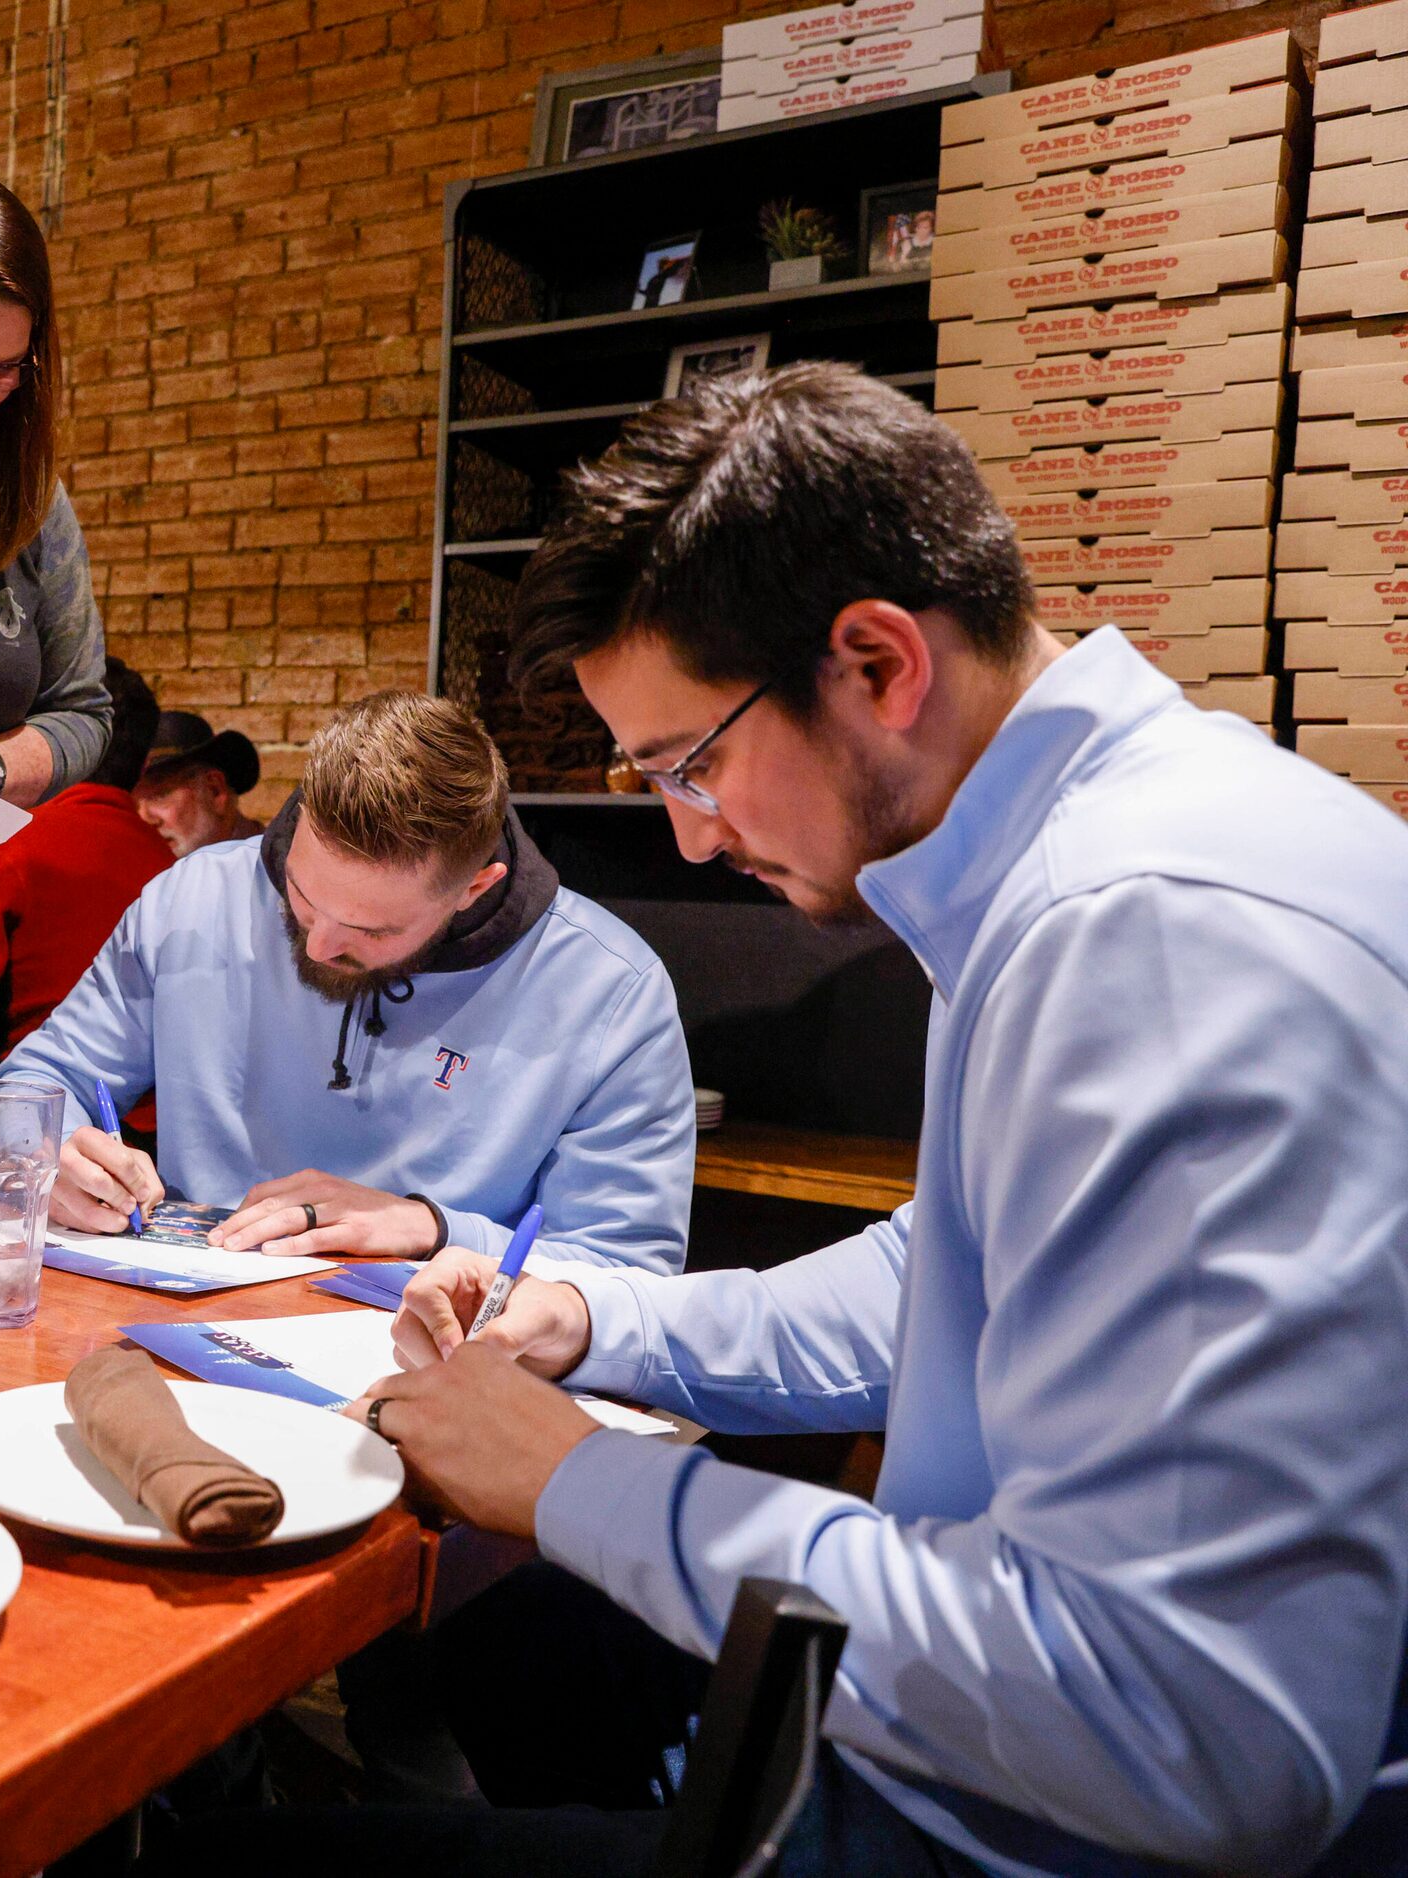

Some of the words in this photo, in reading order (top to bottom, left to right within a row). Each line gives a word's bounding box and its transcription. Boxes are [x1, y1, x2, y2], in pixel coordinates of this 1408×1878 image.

[785, 16, 835, 33] CANE
[857, 1, 914, 19] ROSSO
[784, 54, 833, 70] CANE
[856, 40, 912, 58] ROSSO
[780, 92, 829, 107] CANE
[851, 78, 907, 95] ROSSO
[1021, 87, 1086, 109] CANE
[1115, 64, 1191, 89] ROSSO
[1020, 134, 1086, 155] CANE
[1114, 114, 1191, 137] ROSSO
[1015, 182, 1080, 201] CANE
[1109, 164, 1185, 186] ROSSO
[1010, 226, 1075, 245] CANE
[1103, 209, 1180, 231] ROSSO
[1008, 271, 1073, 289] CANE
[1102, 257, 1178, 276] ROSSO
[1018, 318, 1084, 335] CANE
[1112, 306, 1189, 324] ROSSO
[1014, 364, 1080, 380] CANE
[1108, 354, 1185, 371] ROSSO
[1011, 411, 1077, 426] CANE
[1106, 401, 1181, 418] ROSSO
[1009, 458, 1074, 472] CANE
[1103, 449, 1178, 466] ROSSO
[1097, 497, 1172, 512] ROSSO
[1023, 551, 1069, 563] ANE
[1098, 545, 1174, 558] ROSSO
[1036, 597, 1067, 608] NE
[1095, 593, 1170, 606] ROSSO
[434, 1044, 470, 1090] T
[472, 1297, 500, 1333] Sharpie
[213, 1332, 270, 1361] TEXAS
